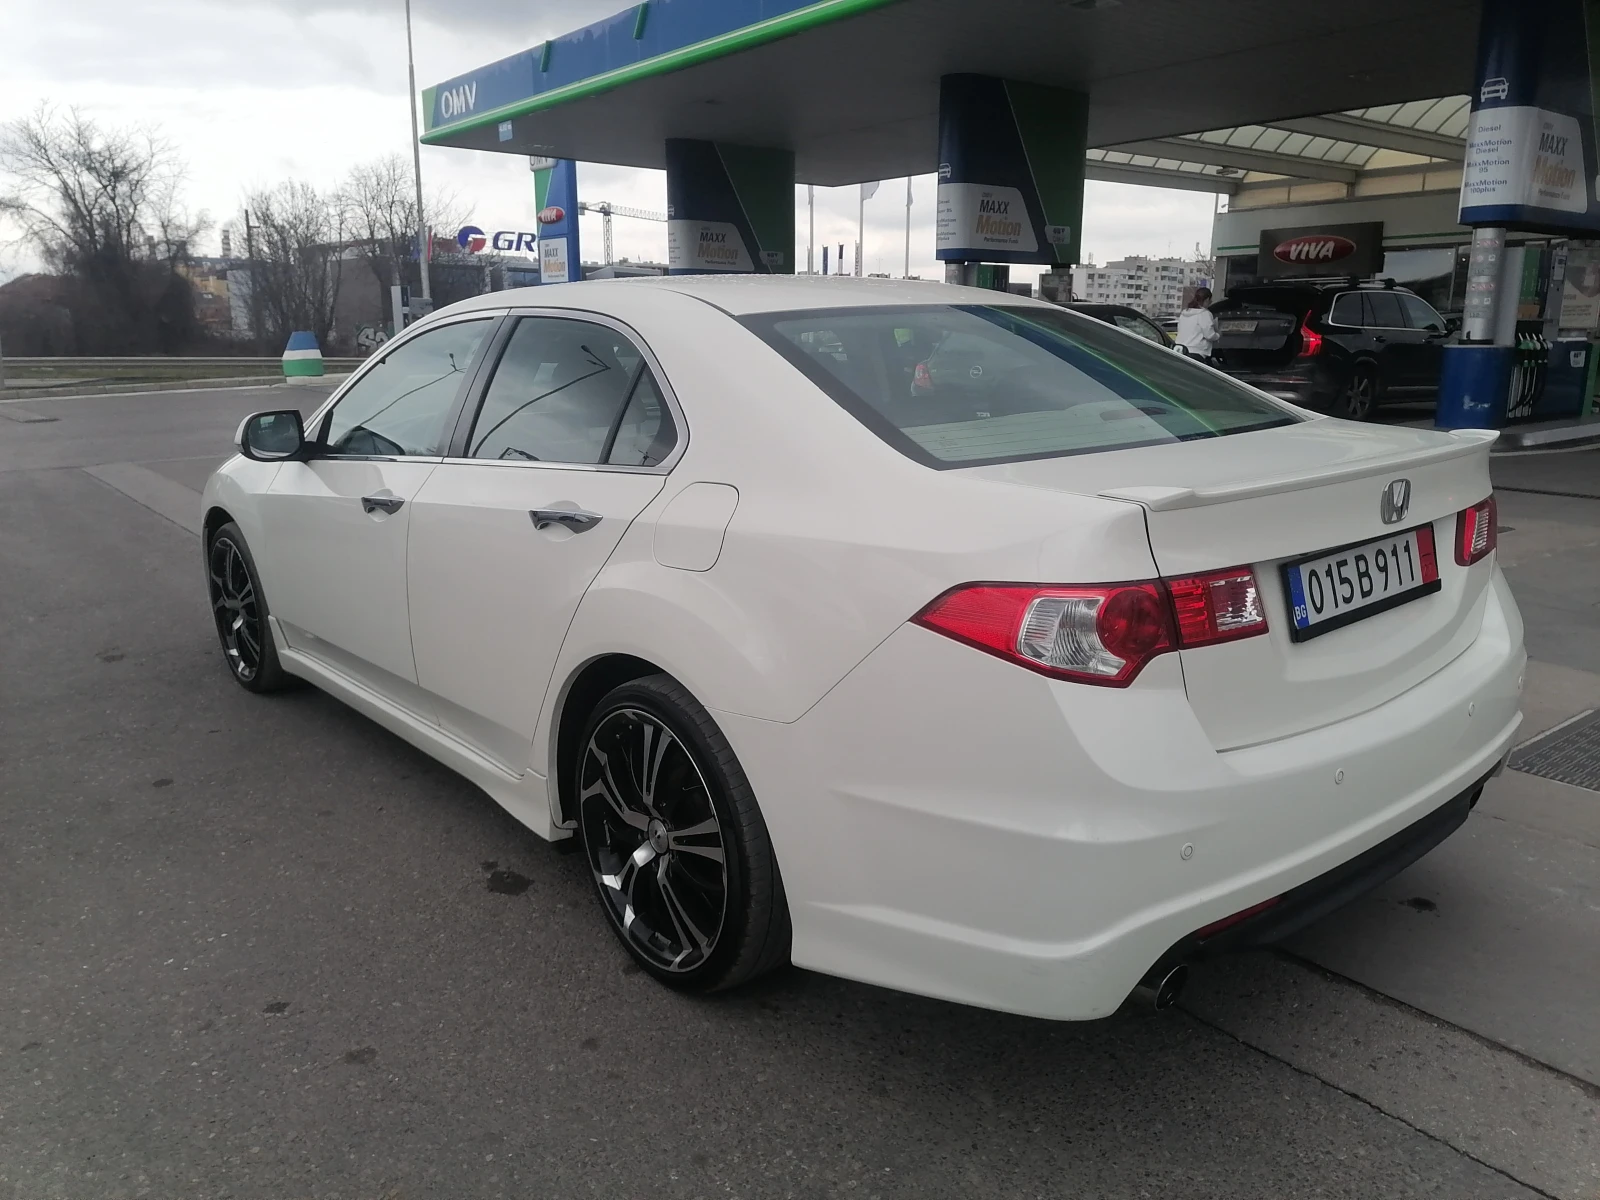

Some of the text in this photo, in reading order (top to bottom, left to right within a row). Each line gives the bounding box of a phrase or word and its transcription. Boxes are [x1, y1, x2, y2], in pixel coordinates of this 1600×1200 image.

[441, 80, 477, 118] OMV
[1478, 124, 1501, 133] Diesel
[1475, 147, 1499, 155] Diesel
[1539, 132, 1568, 156] MAXX
[1530, 155, 1577, 189] Motion
[1470, 187, 1496, 195] 100plus
[979, 199, 1010, 214] MAXX
[975, 214, 1022, 237] Motion
[700, 231, 727, 243] MAXX
[544, 248, 559, 258] MAXX
[697, 242, 739, 260] Motion
[1289, 240, 1335, 261] VIVA
[543, 258, 566, 274] Motion
[1308, 540, 1414, 614] 015B911
[1294, 604, 1307, 621] BG
